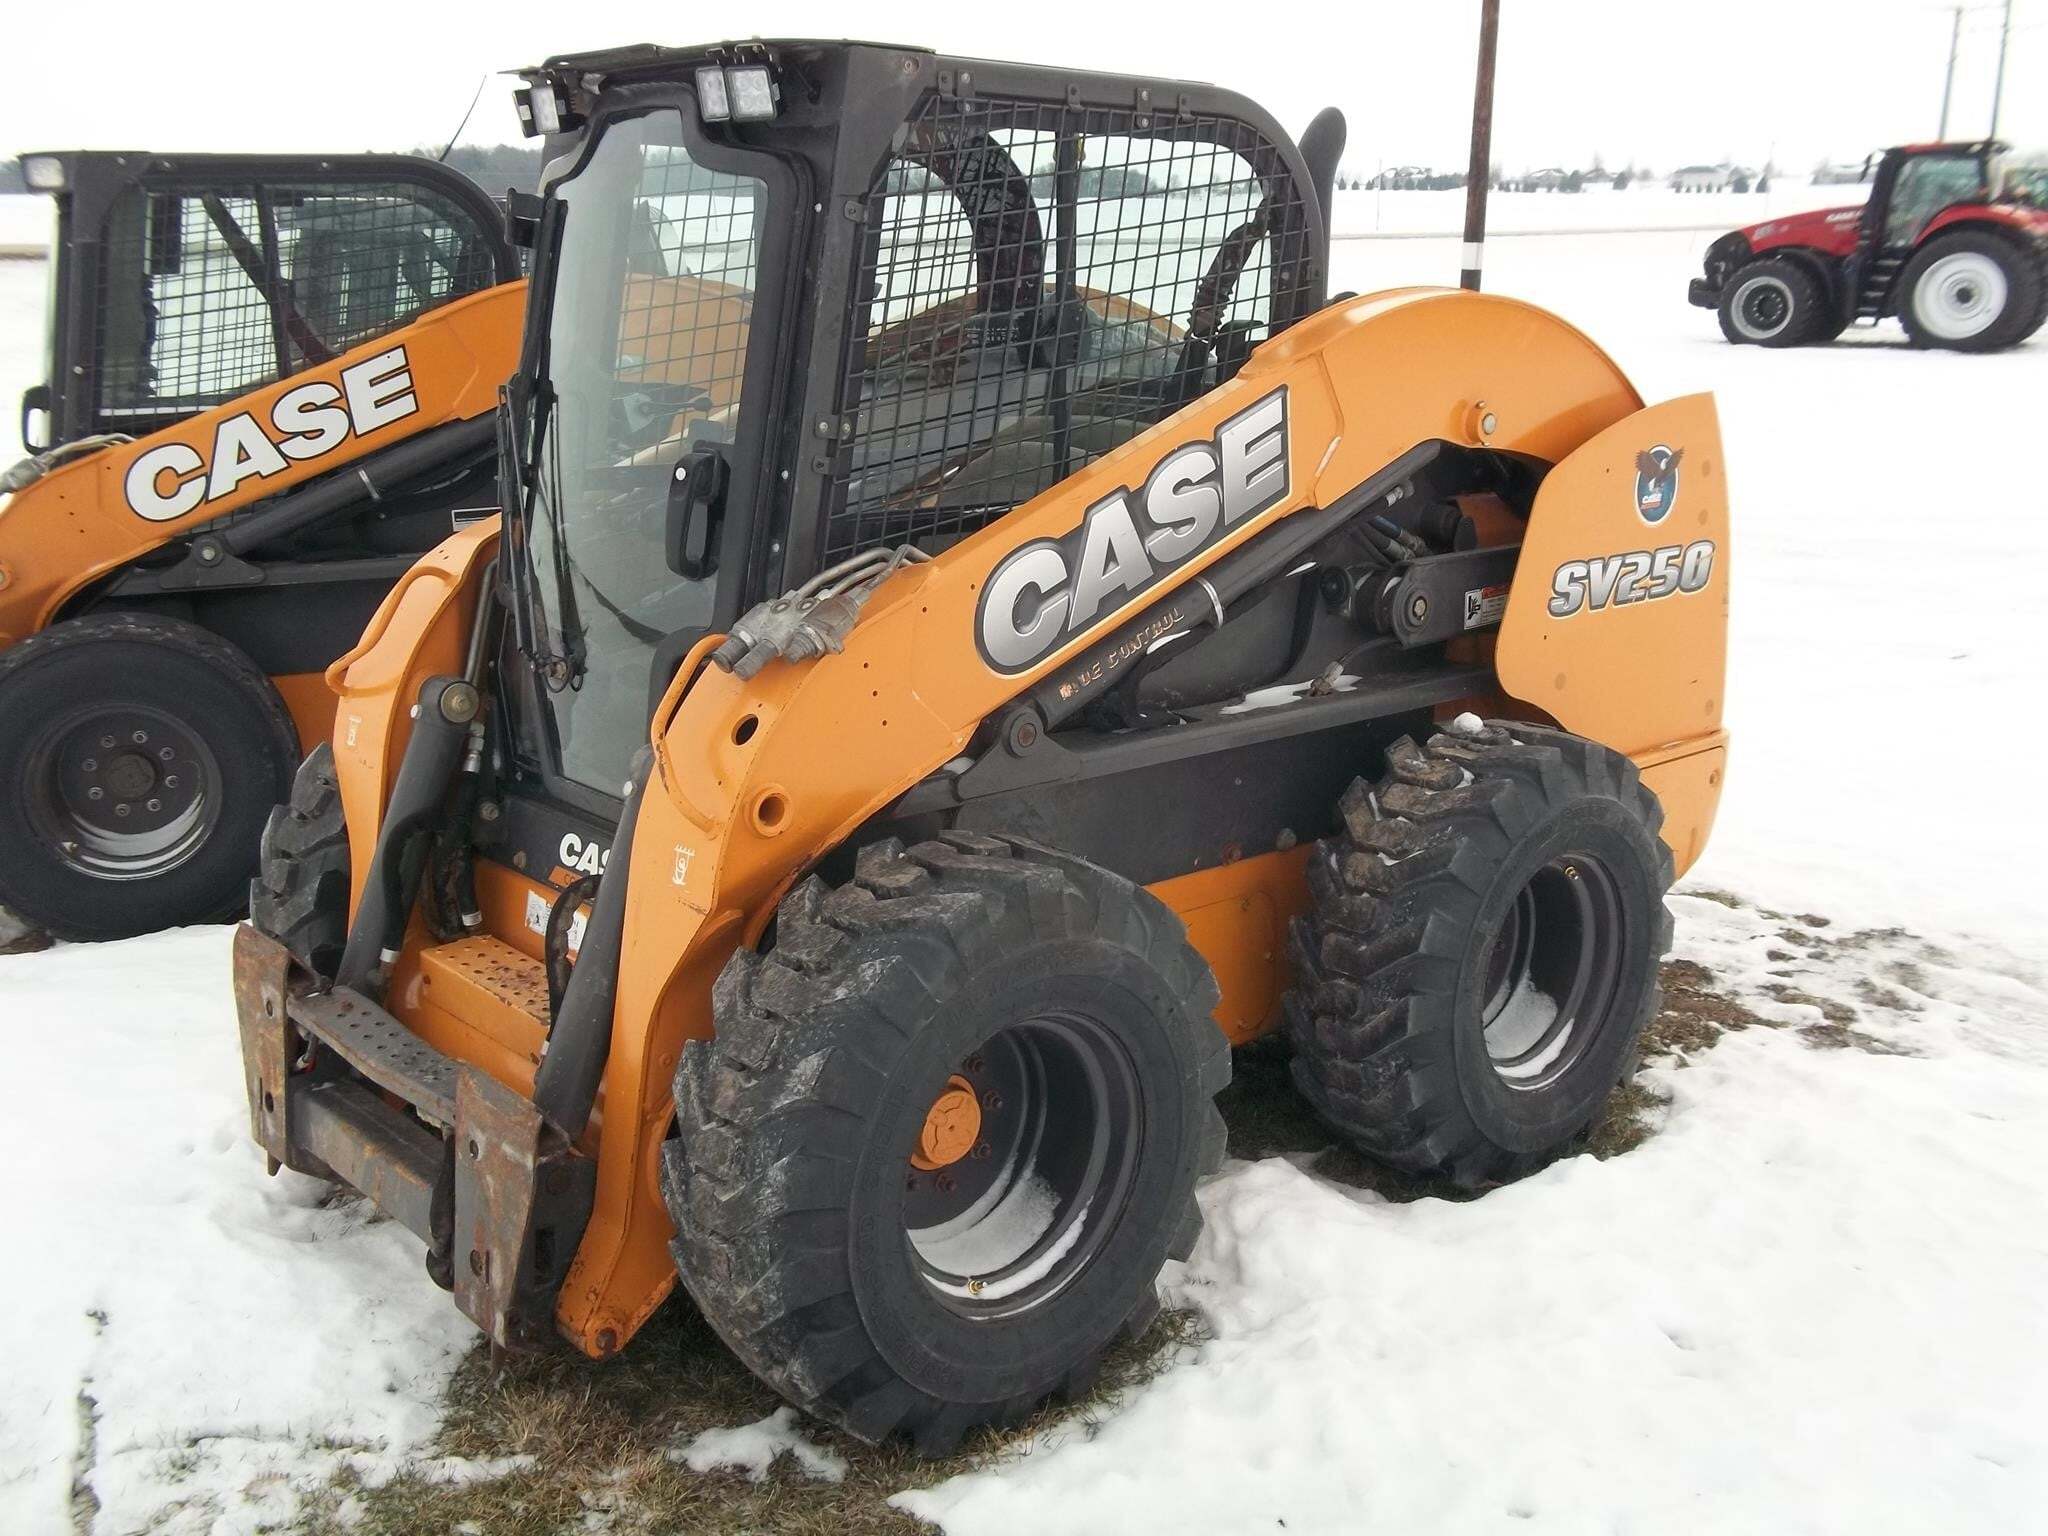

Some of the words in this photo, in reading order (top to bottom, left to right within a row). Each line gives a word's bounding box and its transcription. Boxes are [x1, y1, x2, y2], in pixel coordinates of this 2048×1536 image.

[125, 345, 417, 521] CASE
[979, 390, 1288, 672] CASE
[1548, 541, 1715, 617] SV250
